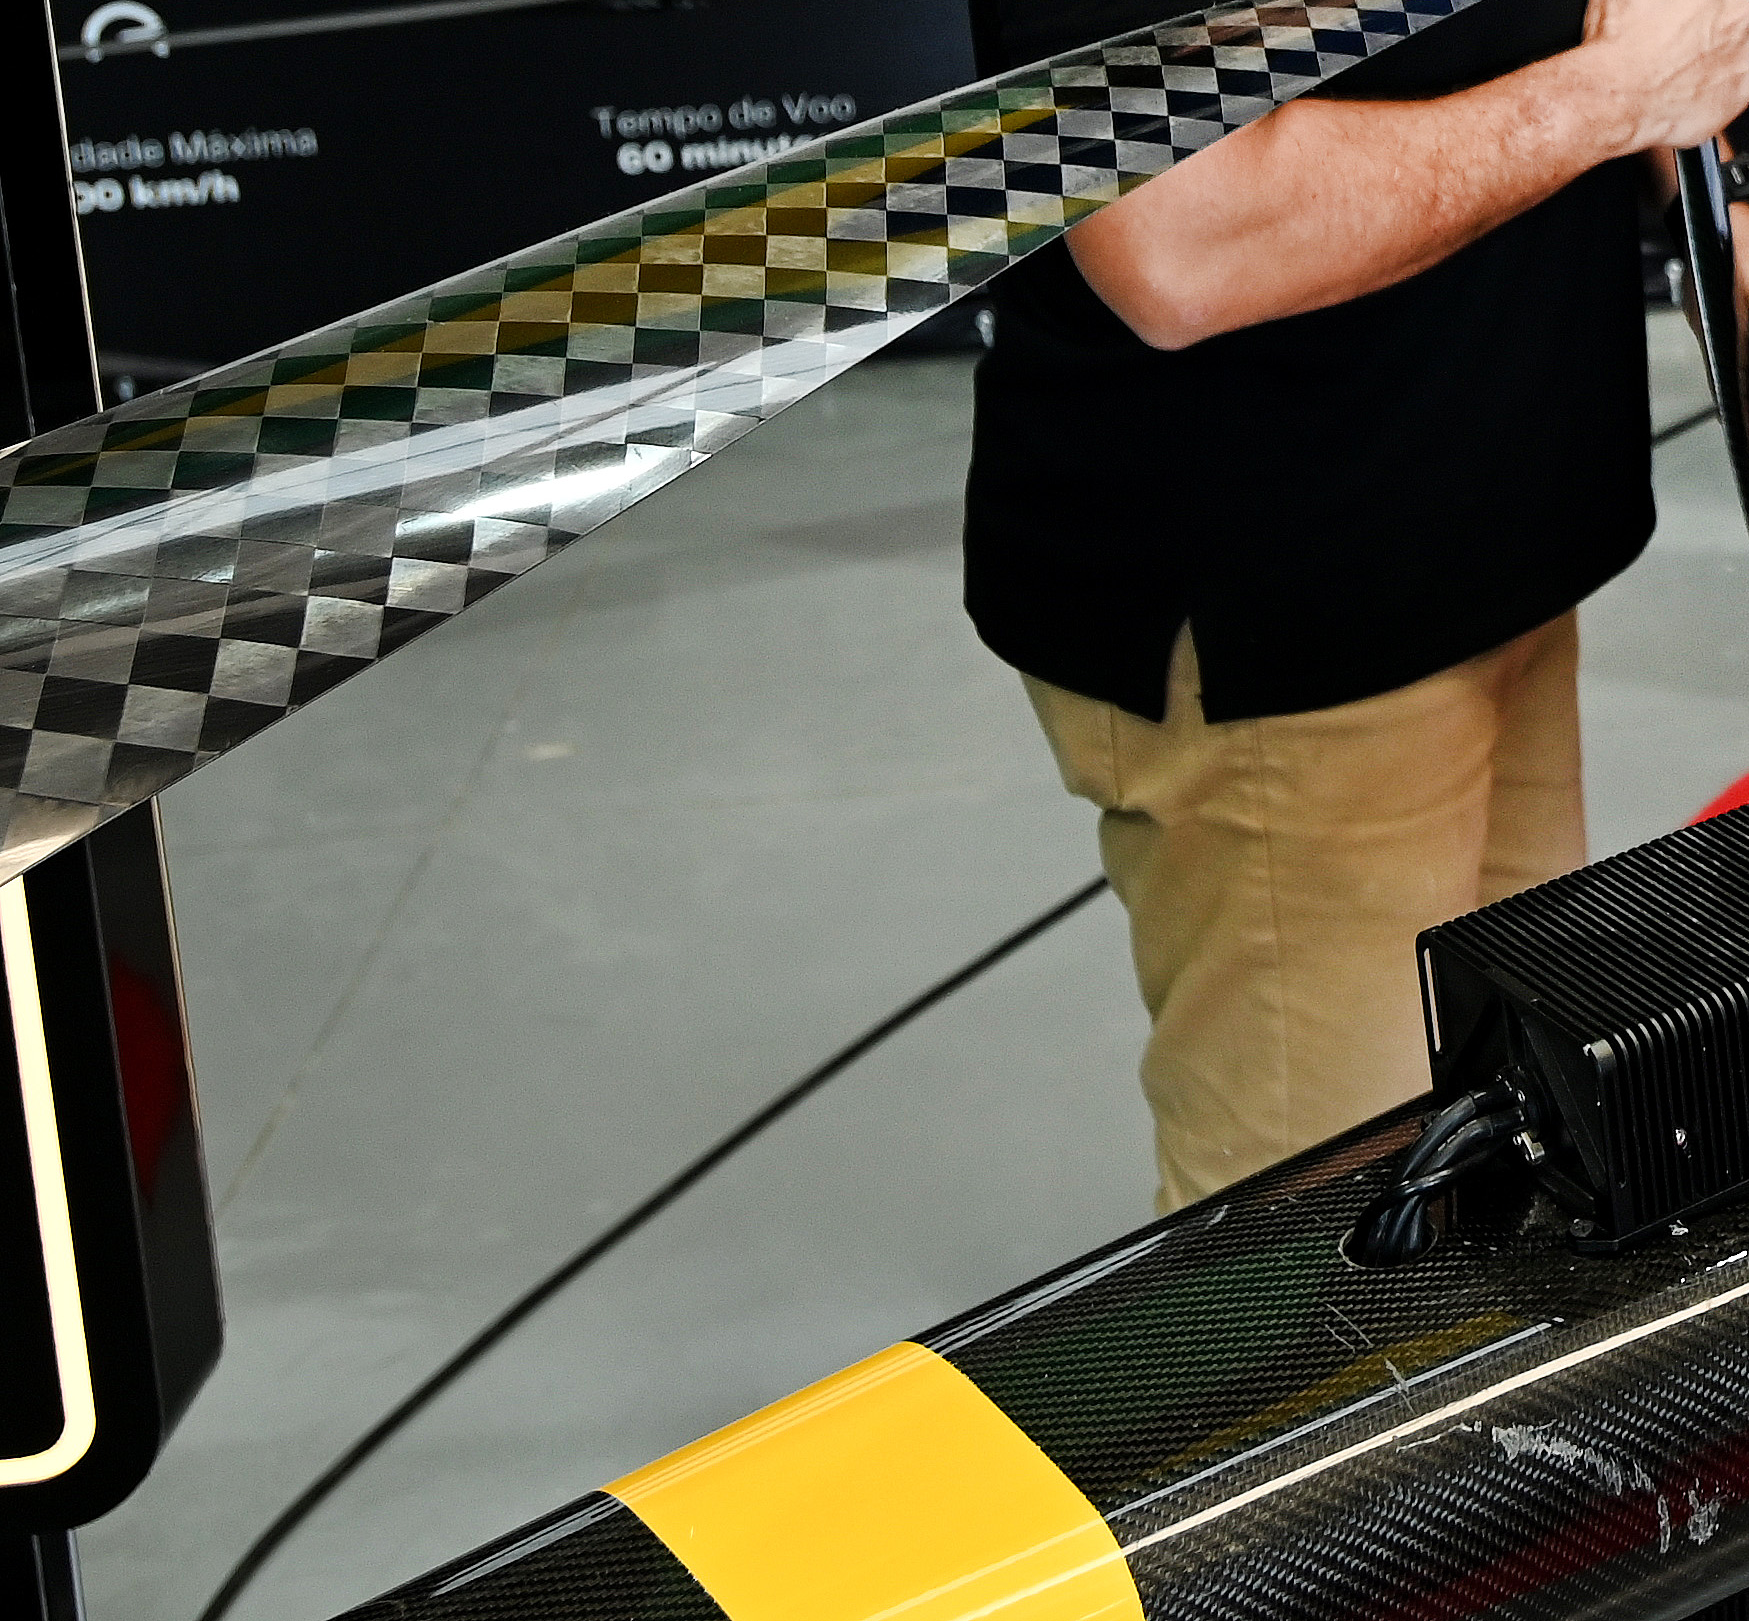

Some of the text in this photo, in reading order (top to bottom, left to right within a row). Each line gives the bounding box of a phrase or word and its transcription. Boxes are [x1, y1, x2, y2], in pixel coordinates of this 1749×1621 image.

[591, 89, 857, 140] Tempo de Voo
[616, 138, 674, 176] 60
[128, 168, 241, 210] km/h
